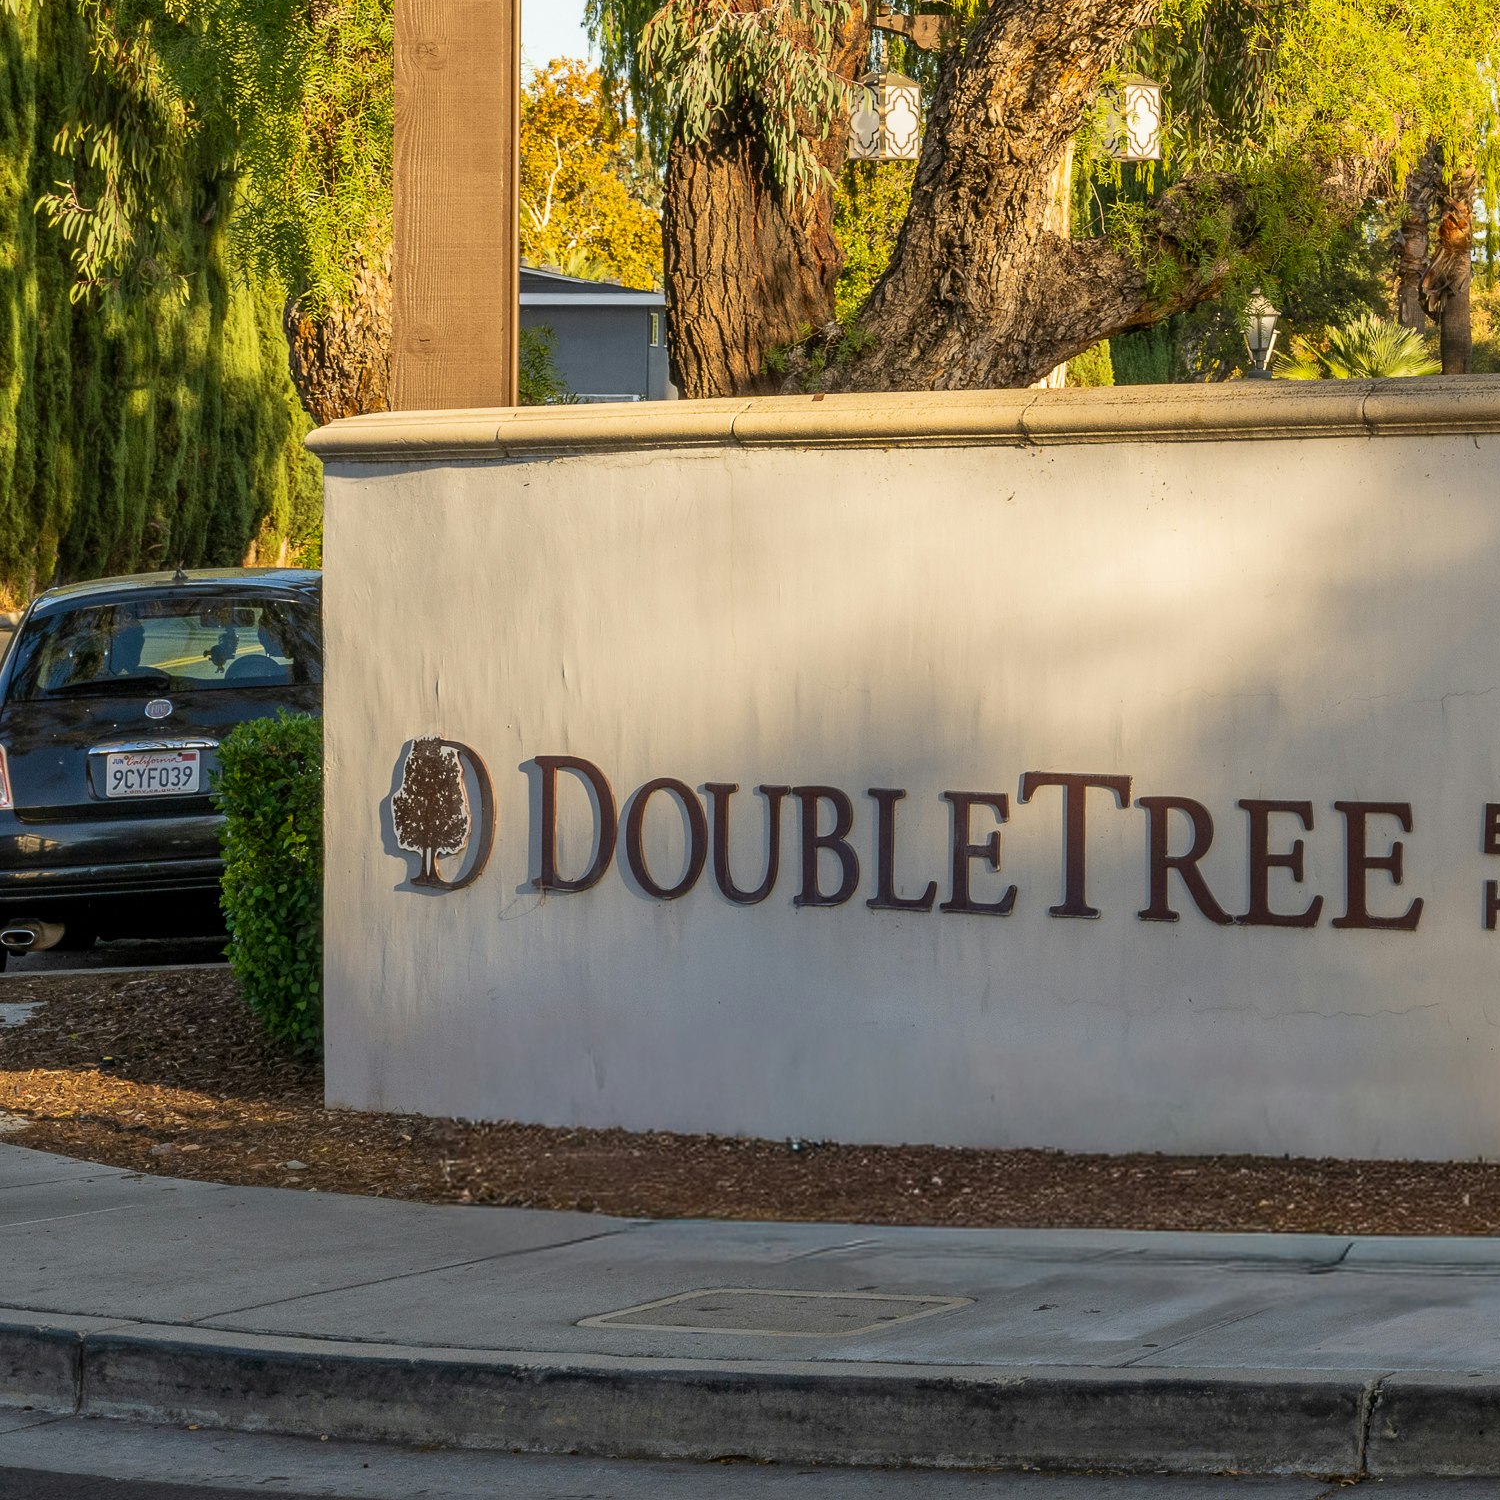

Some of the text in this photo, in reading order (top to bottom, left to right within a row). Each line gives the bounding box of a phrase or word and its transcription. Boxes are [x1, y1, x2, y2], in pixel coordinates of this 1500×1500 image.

[112, 755, 182, 768] JUN California
[112, 766, 193, 790] 9CYF039
